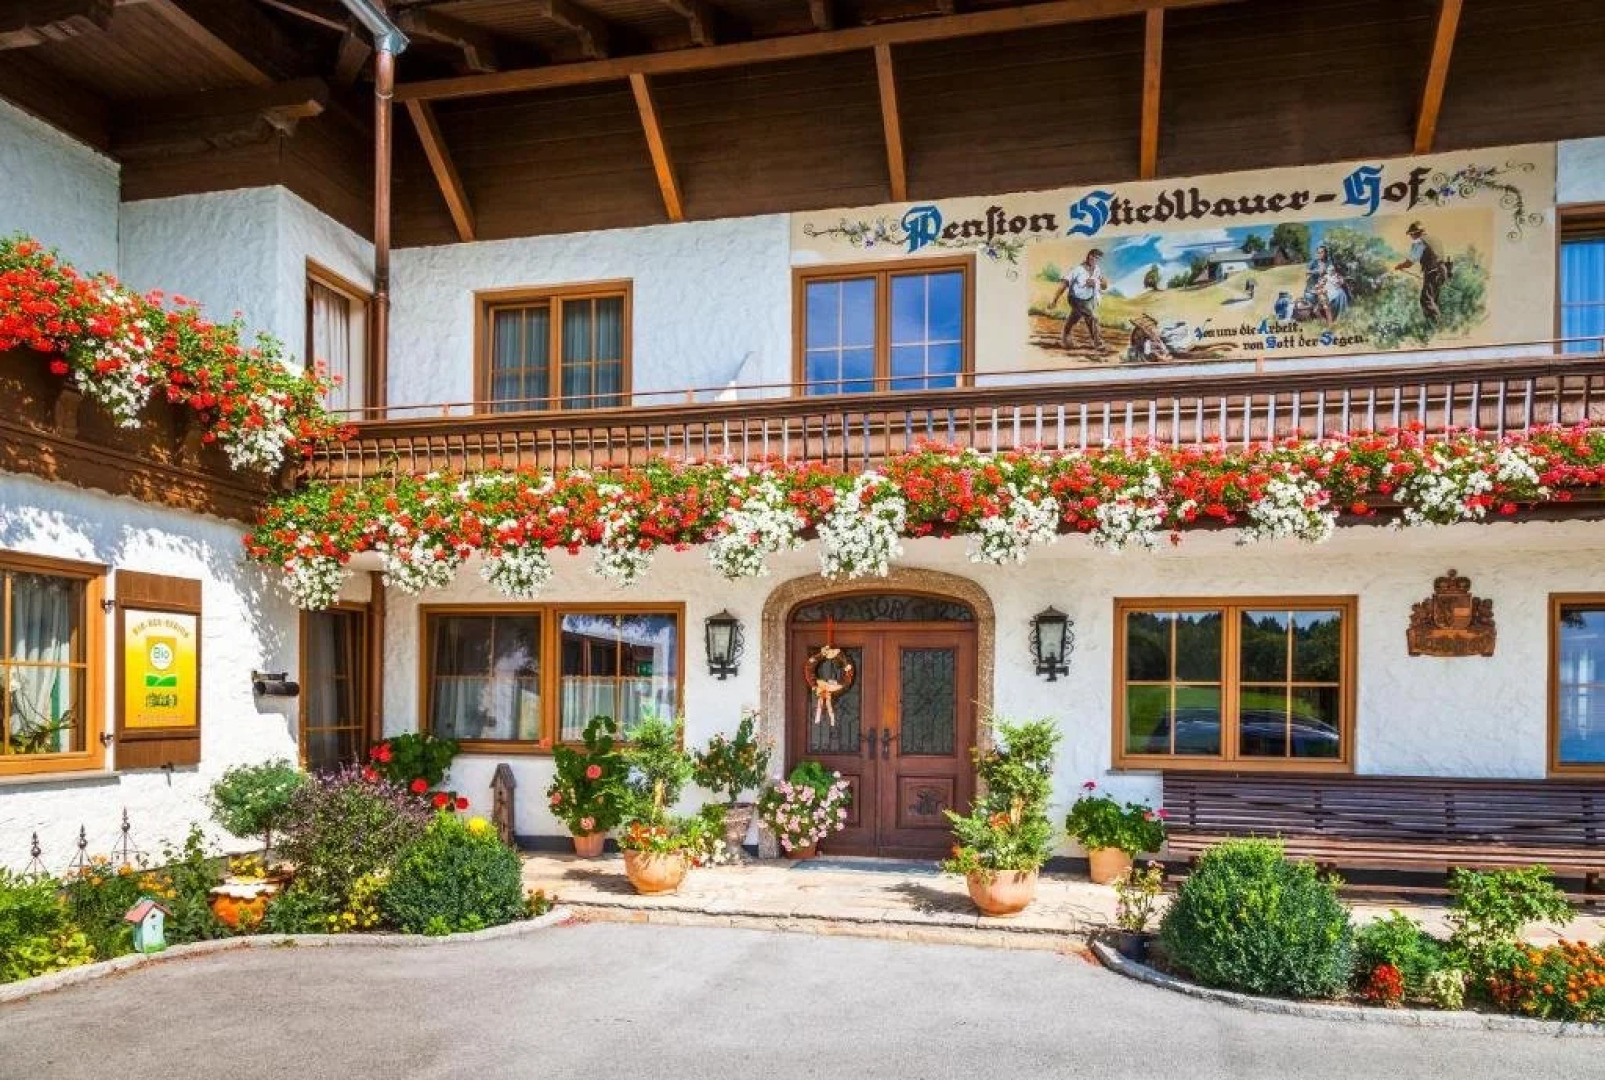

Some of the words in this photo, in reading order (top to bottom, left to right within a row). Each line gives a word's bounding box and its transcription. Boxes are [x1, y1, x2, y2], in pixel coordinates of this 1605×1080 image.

[901, 204, 1058, 254] Pension
[1216, 327, 1238, 337] uns
[1239, 322, 1256, 336] die
[1242, 341, 1264, 351] von
[1299, 334, 1319, 347] der
[153, 646, 169, 659] Bio
